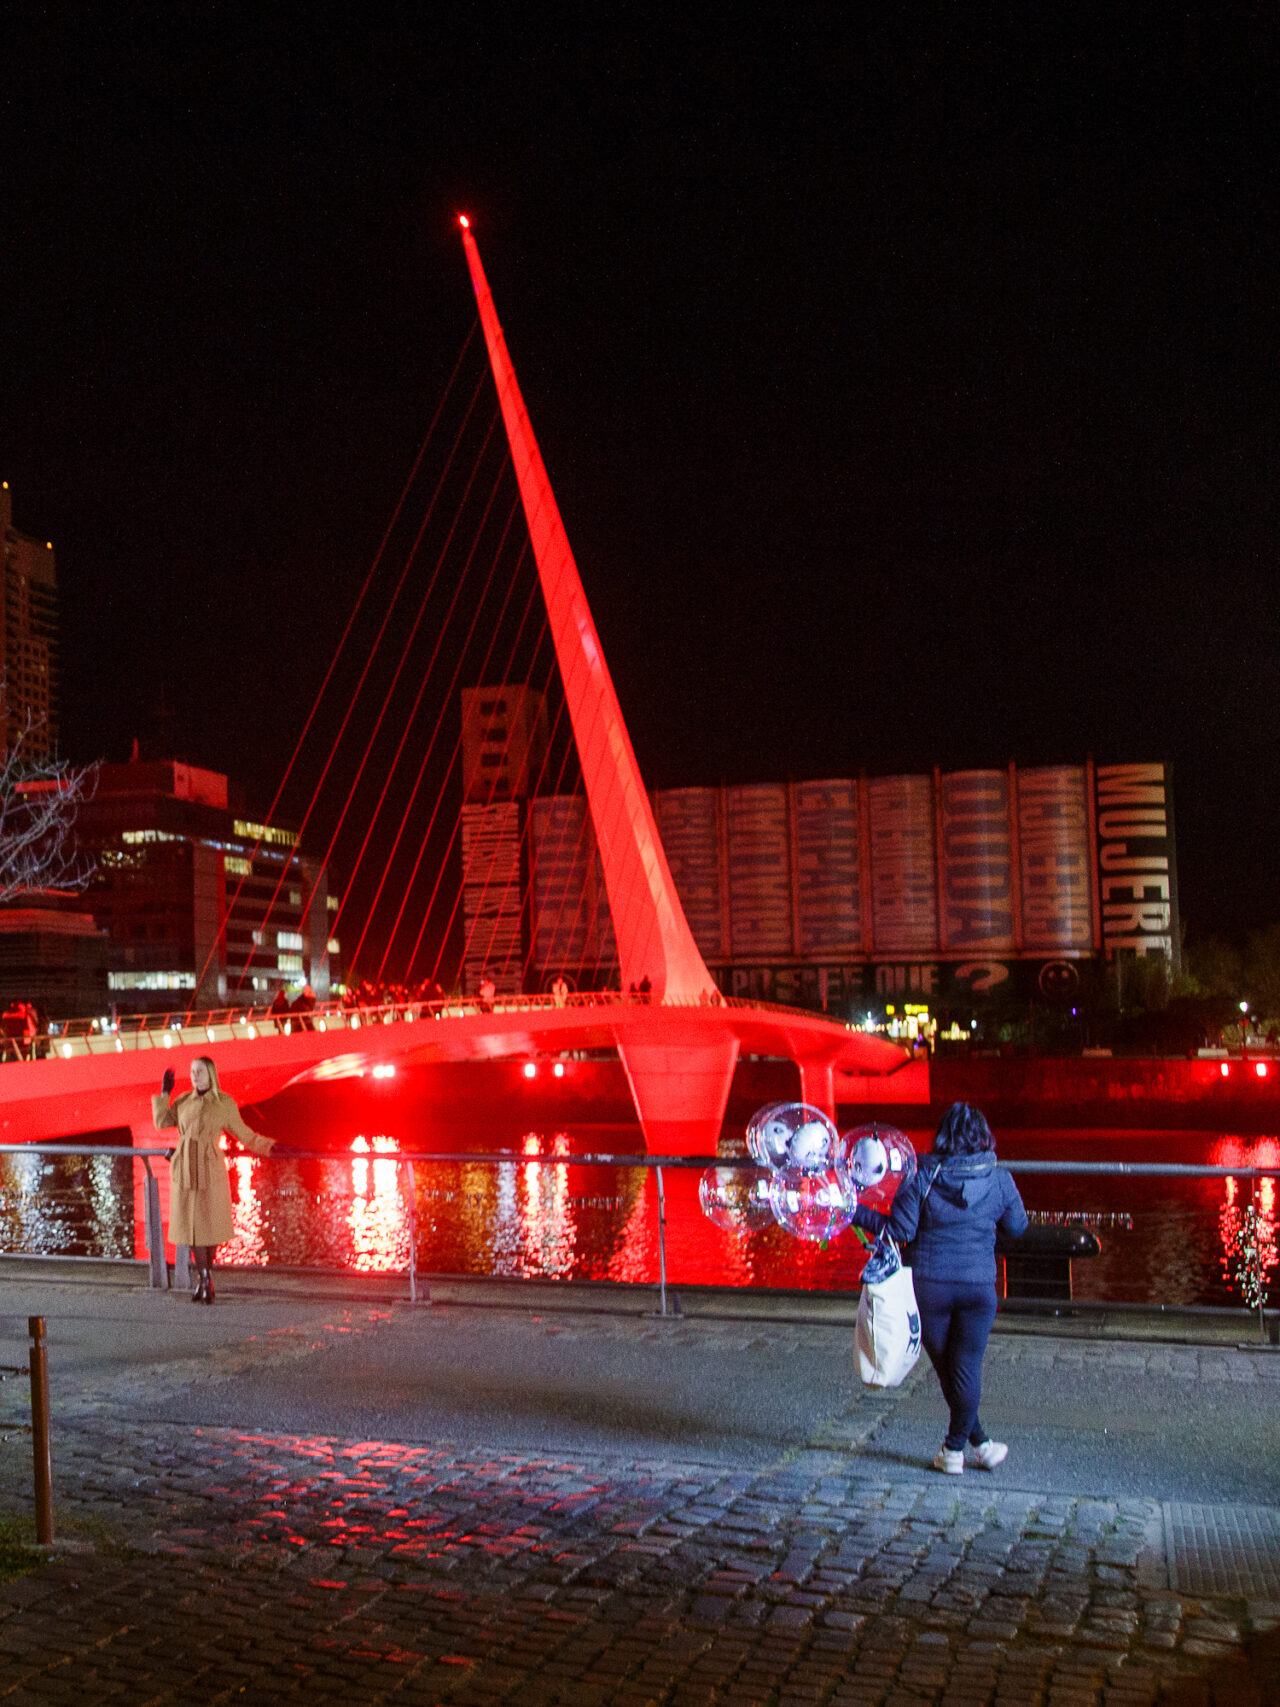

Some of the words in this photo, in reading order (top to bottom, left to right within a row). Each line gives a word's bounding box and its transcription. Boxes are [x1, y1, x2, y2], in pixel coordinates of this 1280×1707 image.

[658, 793, 719, 954] PROPIED
[728, 784, 791, 954] IGUALDAD
[942, 772, 1012, 948] DUDA
[1019, 767, 1090, 945] CREENCIA
[1095, 762, 1172, 966] MUJERE
